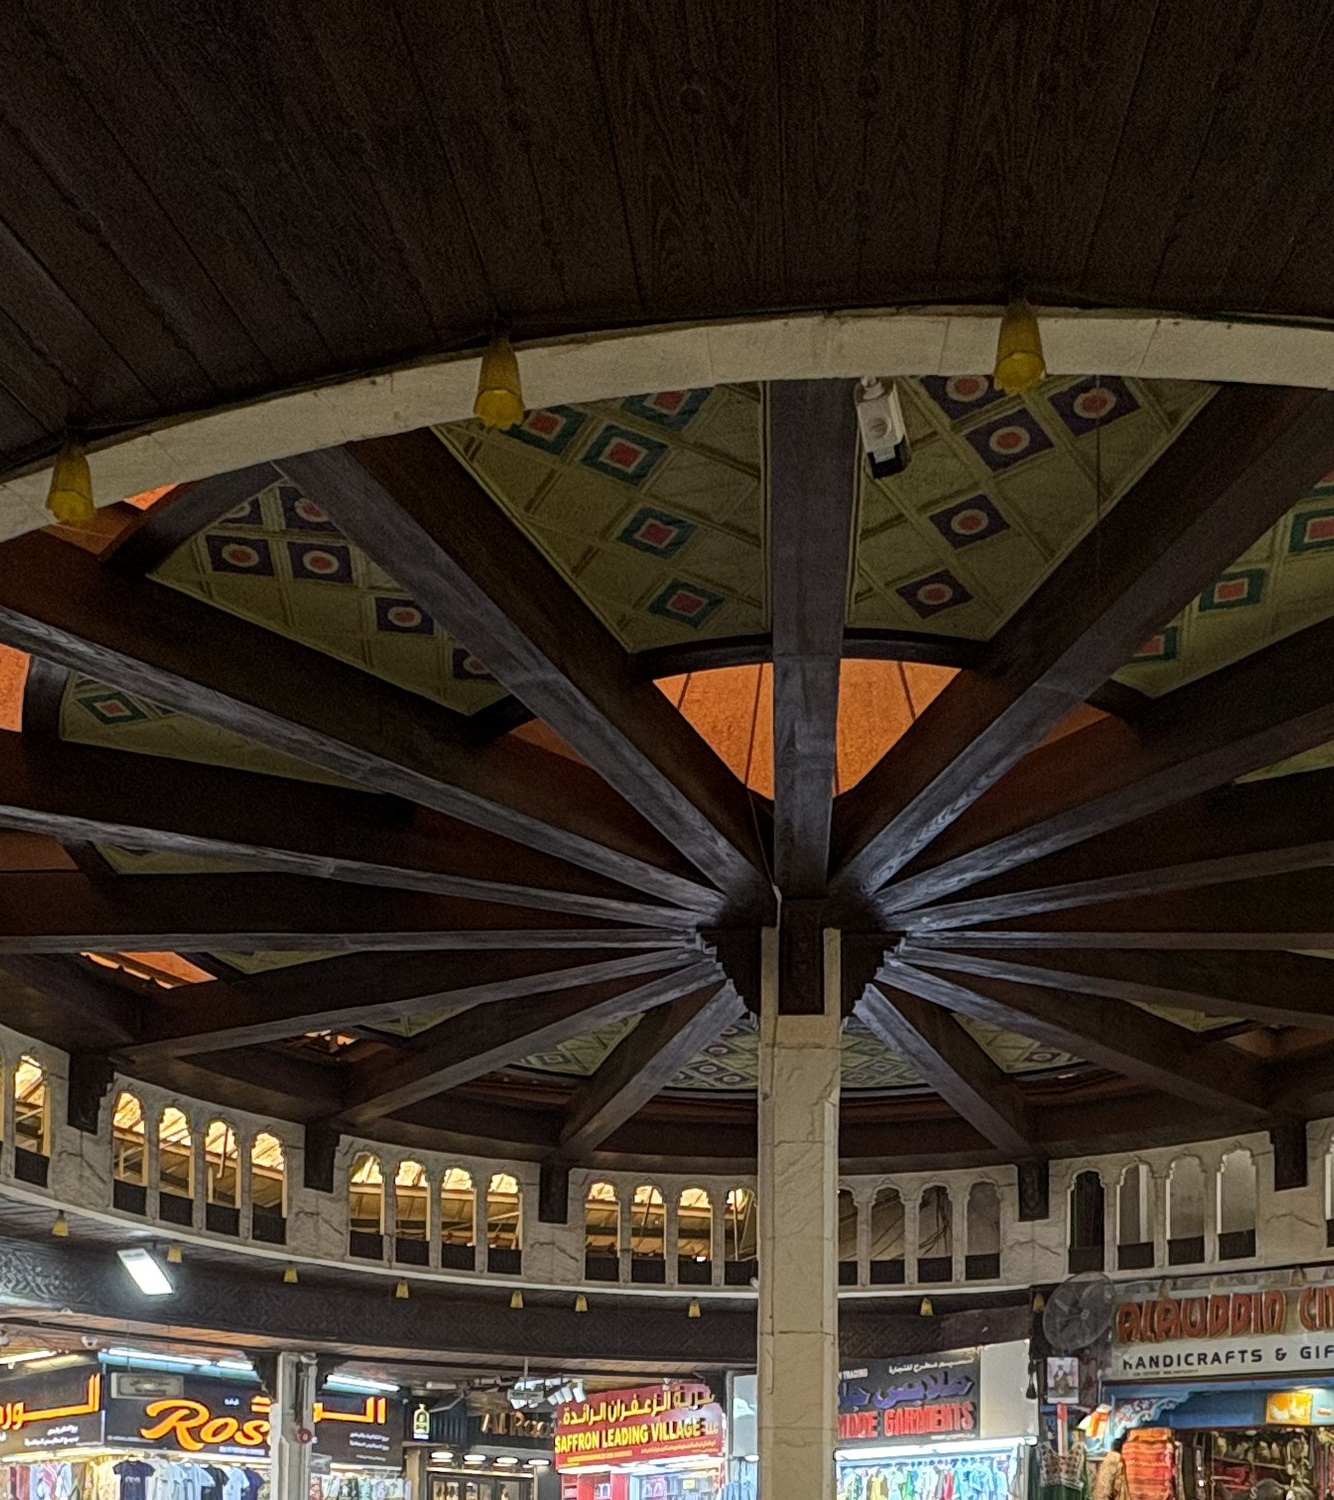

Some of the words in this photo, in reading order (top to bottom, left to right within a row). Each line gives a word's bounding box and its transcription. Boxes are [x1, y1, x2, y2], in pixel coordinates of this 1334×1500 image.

[1117, 1289, 1287, 1343] ALAUDDIN
[1122, 1348, 1263, 1371] HANDICRAFTS
[1275, 1347, 1288, 1362] &
[562, 1401, 607, 1426] الرائدة
[606, 1391, 672, 1423] الزعفران
[883, 1401, 974, 1437] GARMENTS
[139, 1398, 272, 1453] Ros
[554, 1429, 600, 1454] SAFFRON
[601, 1423, 649, 1449] LEADING
[650, 1417, 701, 1443] VILLAGE
